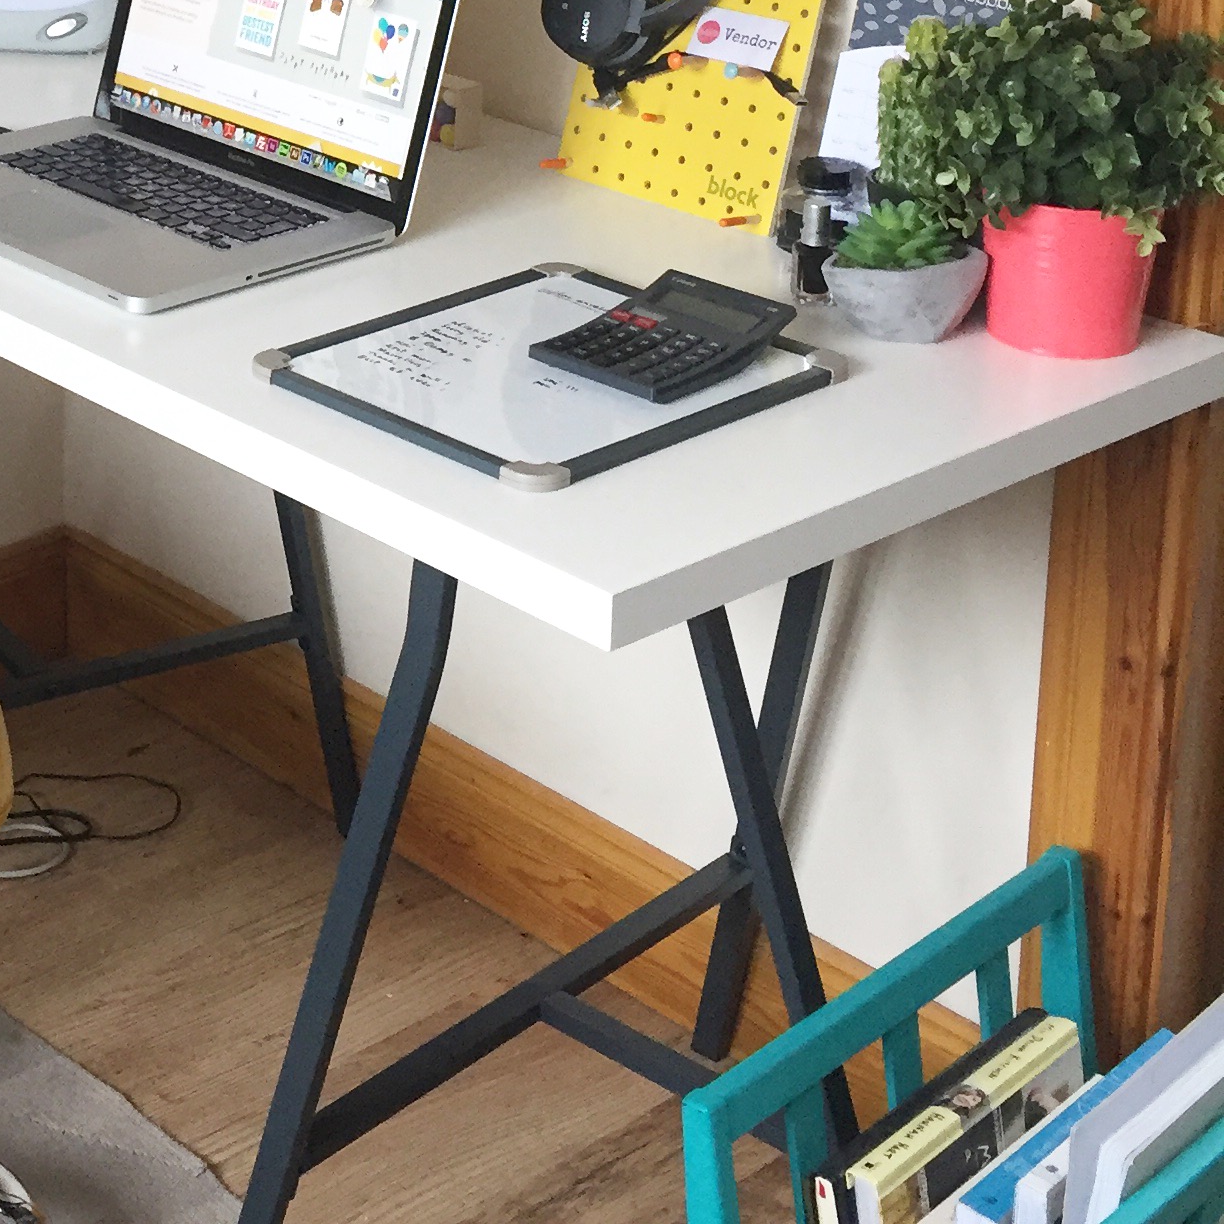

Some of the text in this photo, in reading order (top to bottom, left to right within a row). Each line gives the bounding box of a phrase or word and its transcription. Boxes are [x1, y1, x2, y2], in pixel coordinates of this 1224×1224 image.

[239, 27, 273, 48] FRIEND
[580, 10, 591, 44] SONY
[724, 27, 778, 51] Vendor
[706, 174, 760, 210] block
